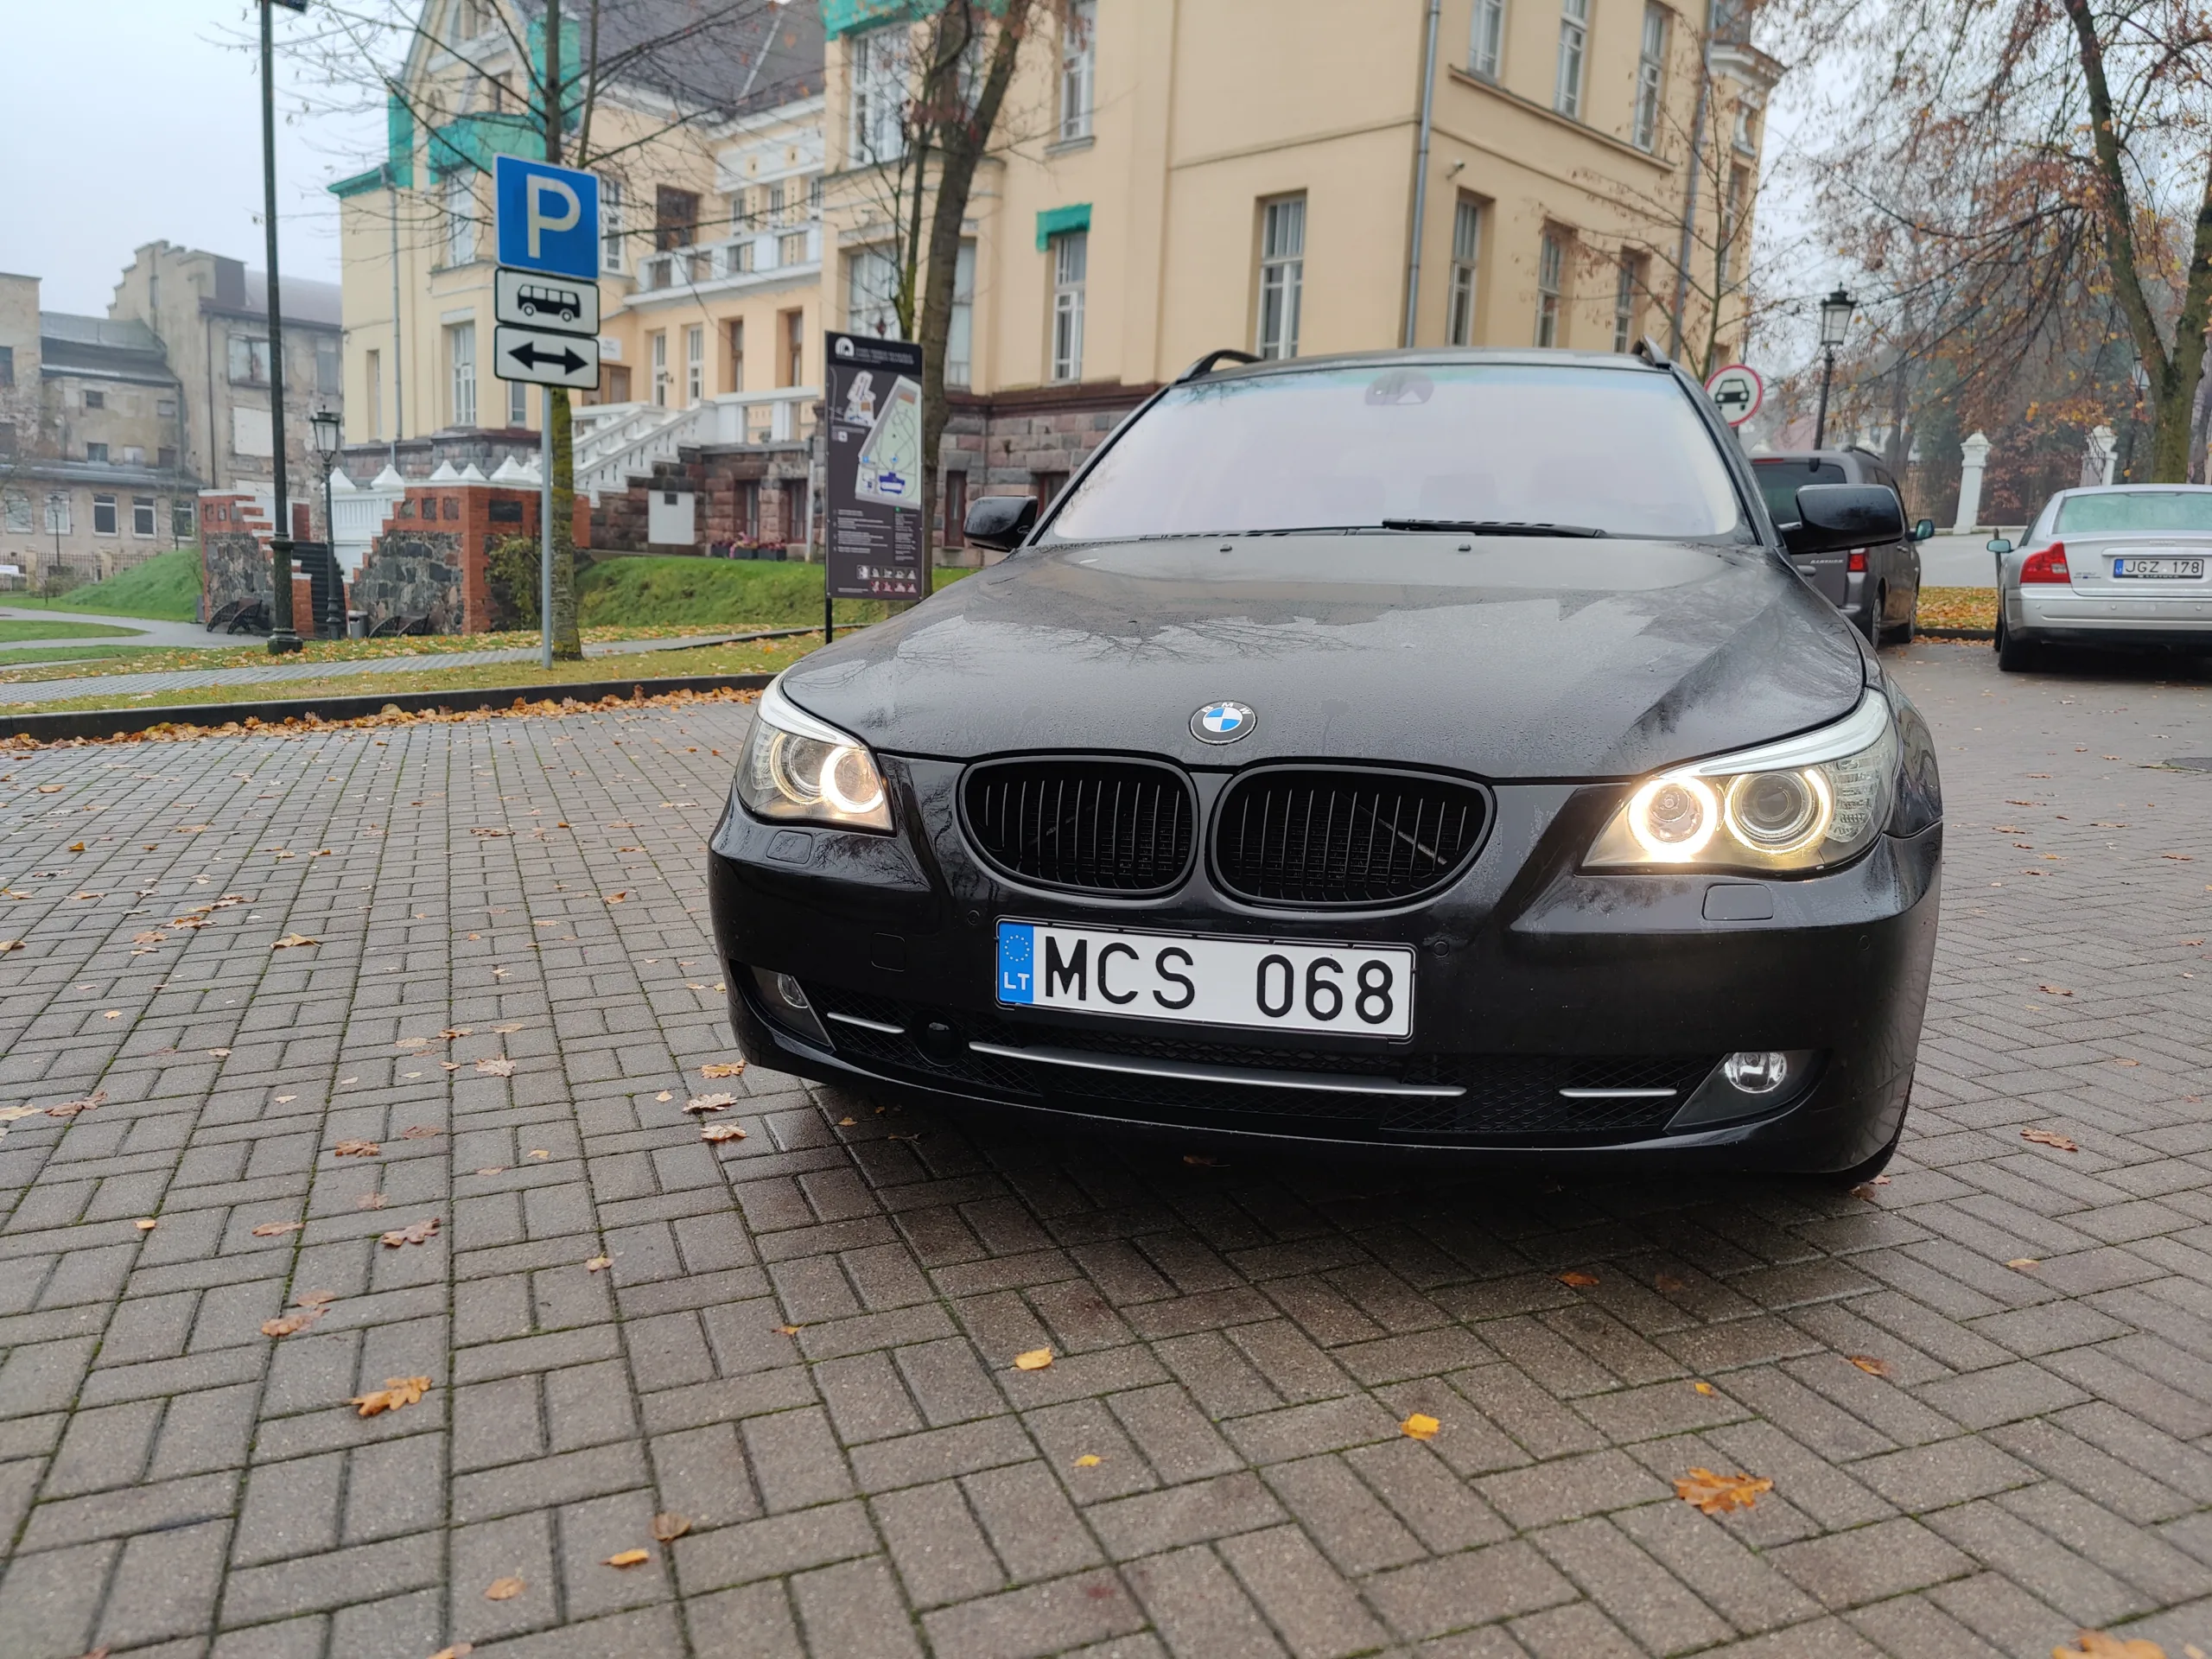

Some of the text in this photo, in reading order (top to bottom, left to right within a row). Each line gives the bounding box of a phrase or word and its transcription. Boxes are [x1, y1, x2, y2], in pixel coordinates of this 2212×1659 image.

[526, 173, 582, 258] P
[2125, 561, 2200, 574] JGZ 178
[1201, 702, 1252, 715] BMW
[1003, 971, 1031, 991] LT
[1045, 936, 1394, 1025] MCS 068
